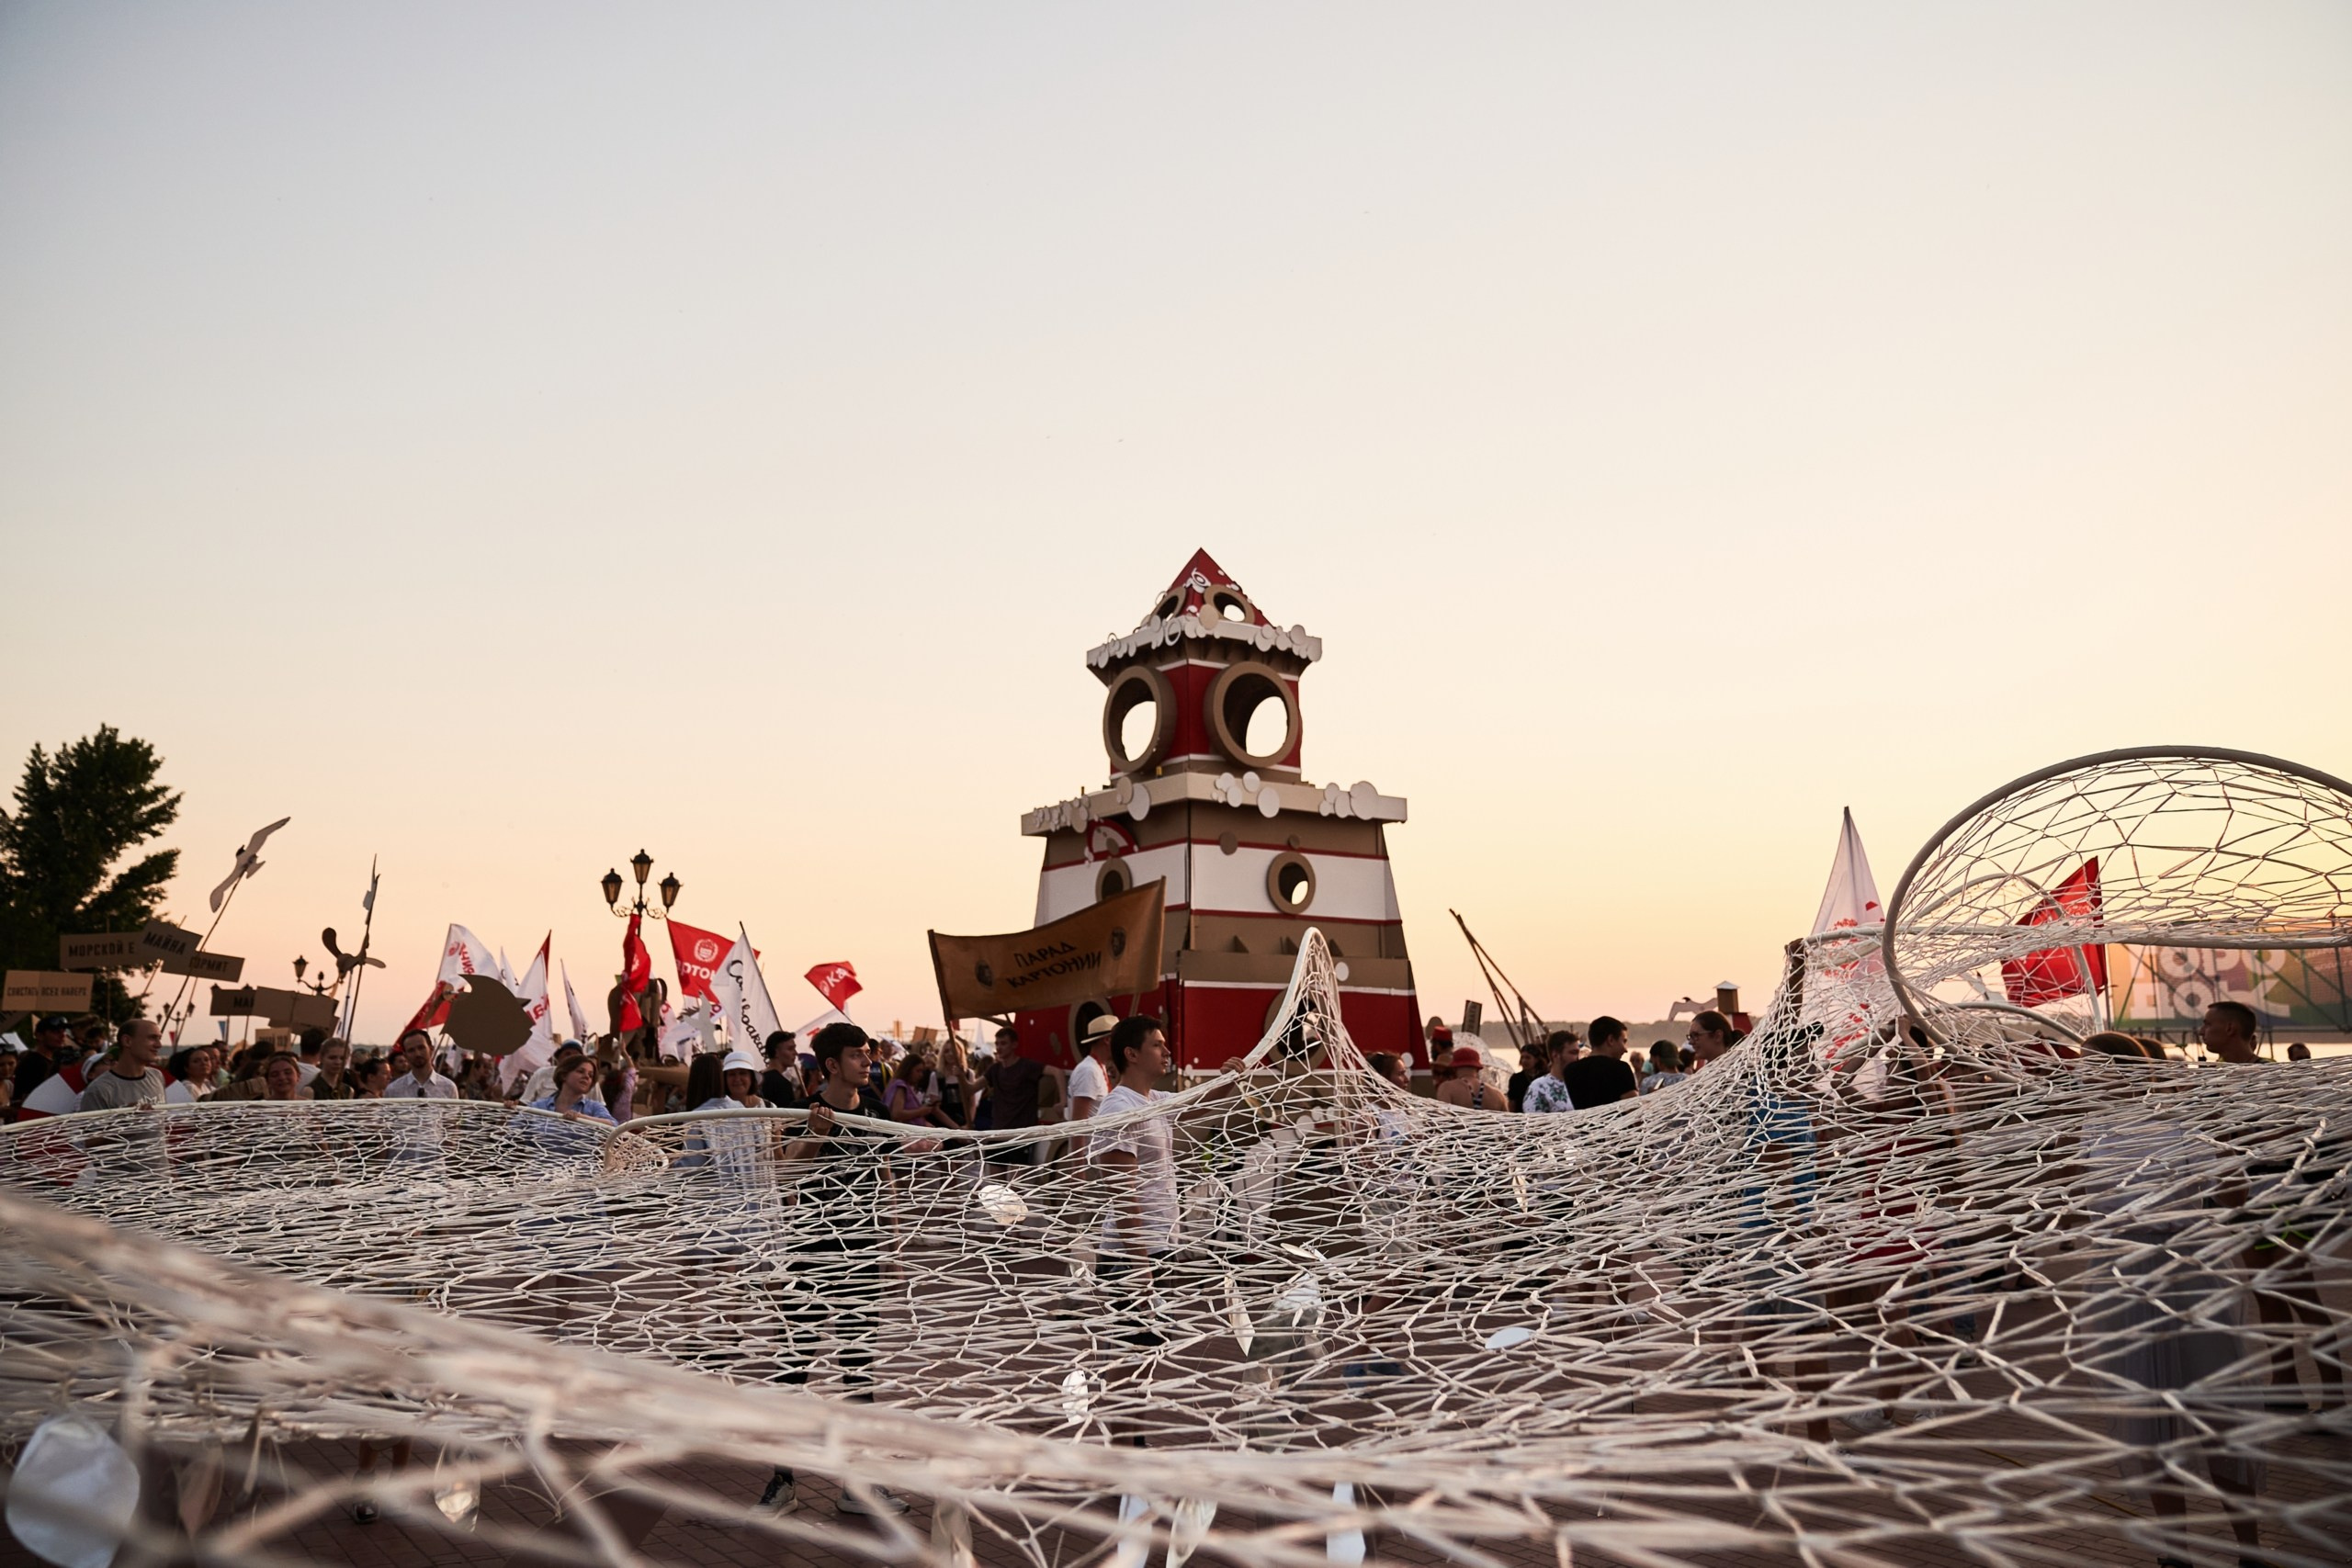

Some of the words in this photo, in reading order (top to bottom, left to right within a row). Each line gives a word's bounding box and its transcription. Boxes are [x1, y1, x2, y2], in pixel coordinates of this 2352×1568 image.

[69, 940, 123, 957] МОРСКОЙ
[142, 932, 187, 955] МАЙНА
[1013, 942, 1077, 967] ПАРАД
[1007, 951, 1102, 988] КАРТОНИИ
